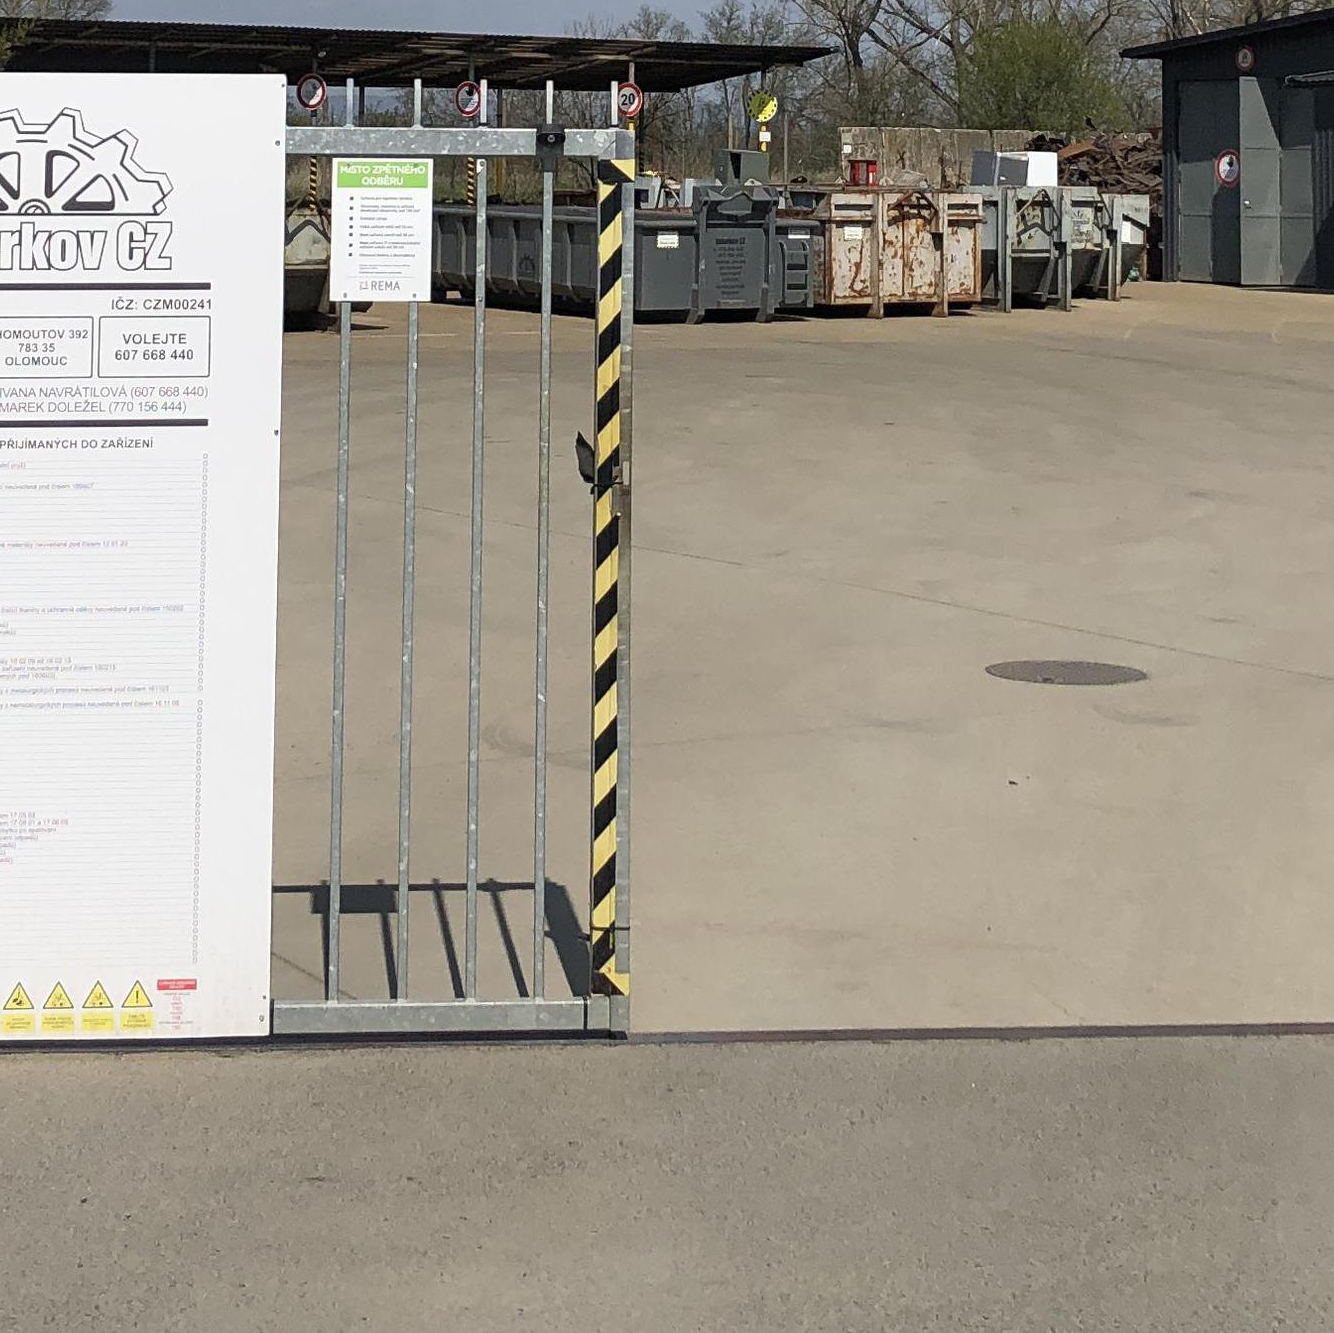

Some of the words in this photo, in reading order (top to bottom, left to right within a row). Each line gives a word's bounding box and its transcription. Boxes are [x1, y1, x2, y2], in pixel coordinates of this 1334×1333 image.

[621, 93, 636, 106] 20
[116, 220, 174, 271] CZ
[371, 281, 401, 291] REMA
[111, 296, 138, 310] IČZ:
[142, 298, 212, 310] CZM00241
[68, 329, 89, 340] 392
[122, 333, 187, 345] VOLEJTE
[18, 343, 39, 353] 783
[42, 343, 55, 353] 35
[5, 356, 68, 366] OLOMOUC
[115, 349, 138, 361] 607
[142, 349, 166, 361] 668
[170, 349, 194, 361] 440
[0, 387, 37, 398] IVANA
[38, 385, 127, 398] NAVRÁTILOVÁ
[130, 386, 155, 399] (607
[158, 386, 181, 398] 668
[182, 386, 209, 399] 440)
[47, 399, 106, 413] DOLEŽEL
[108, 401, 134, 414] (770
[137, 401, 159, 413] 156
[160, 401, 187, 414] 444)
[0, 437, 78, 450] PŘIJÍMANÝCH
[81, 439, 98, 450] DO
[101, 436, 154, 450] ZAŘÍZENÍ
